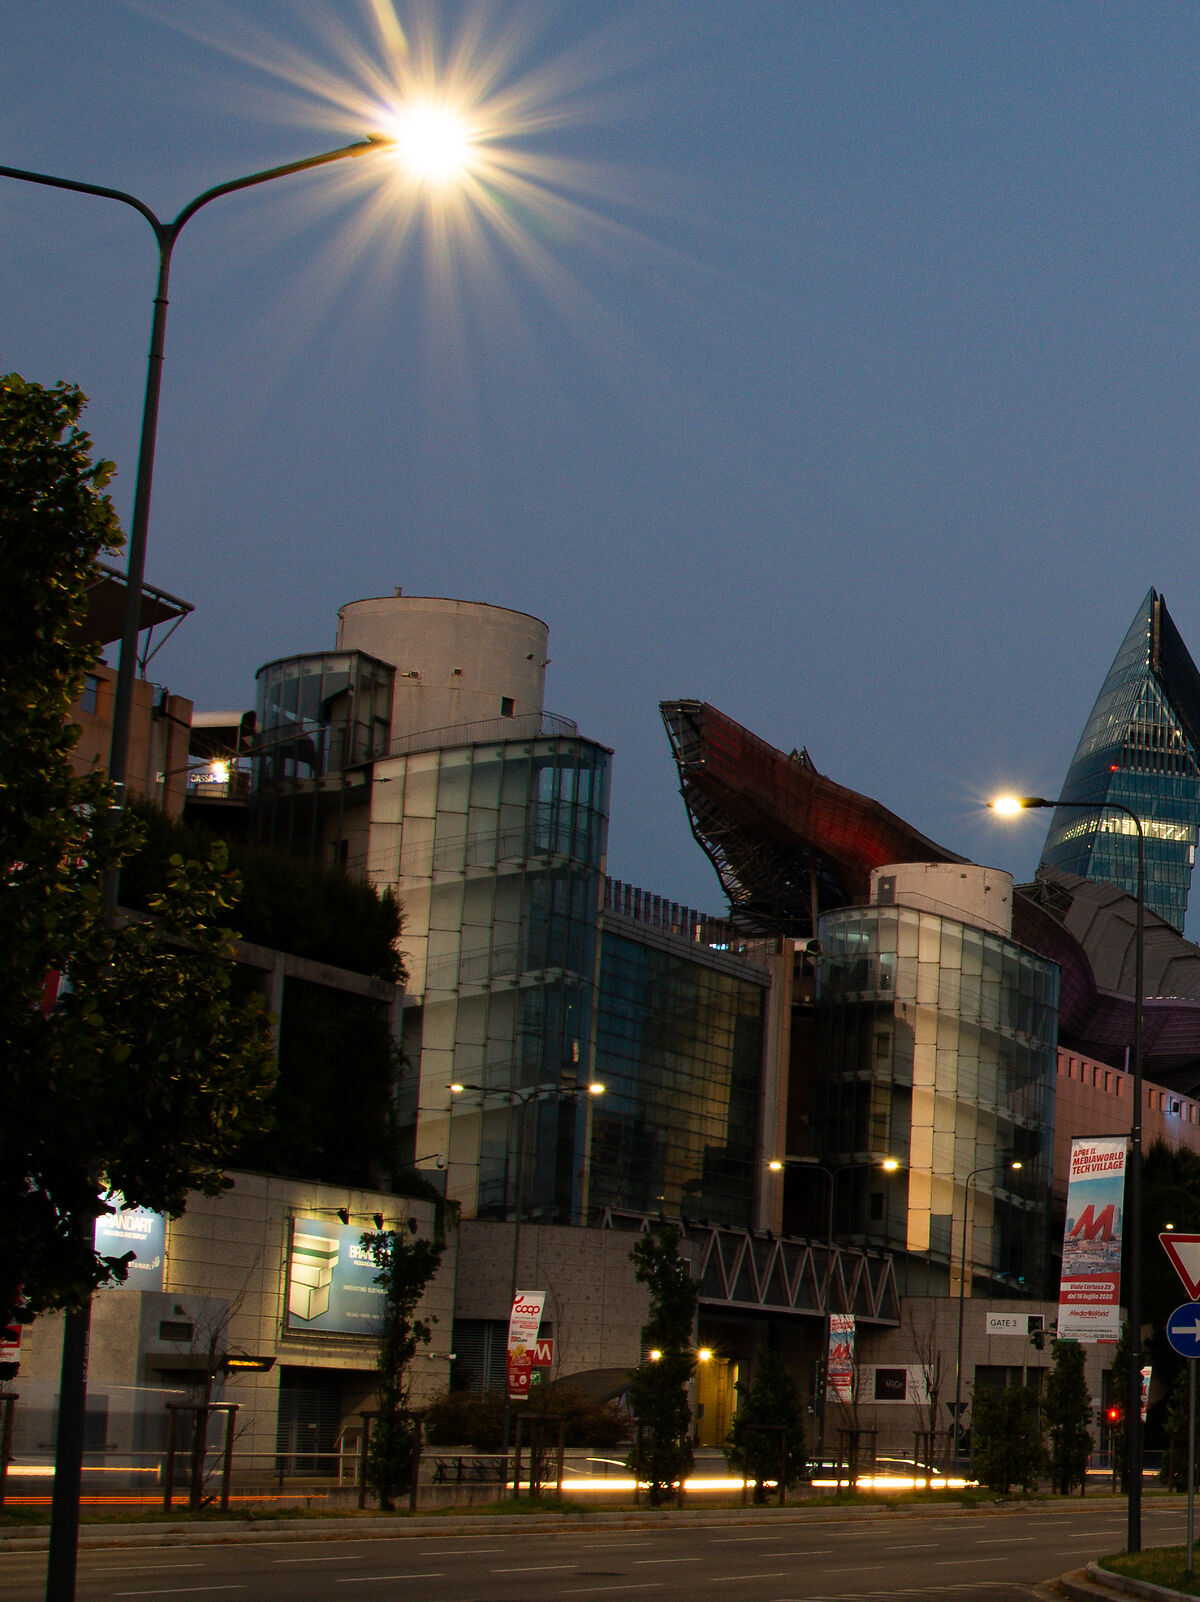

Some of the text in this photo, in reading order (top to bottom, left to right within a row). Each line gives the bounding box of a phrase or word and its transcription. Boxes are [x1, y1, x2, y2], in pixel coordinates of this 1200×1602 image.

[1073, 1147, 1096, 1158] APRE IL
[1073, 1151, 1124, 1167] MEDIAWORLD
[1072, 1160, 1124, 1175] TECH VILLAGE
[515, 1305, 541, 1316] coop
[990, 1319, 1017, 1327] GATE 3
[533, 1343, 552, 1360] M
